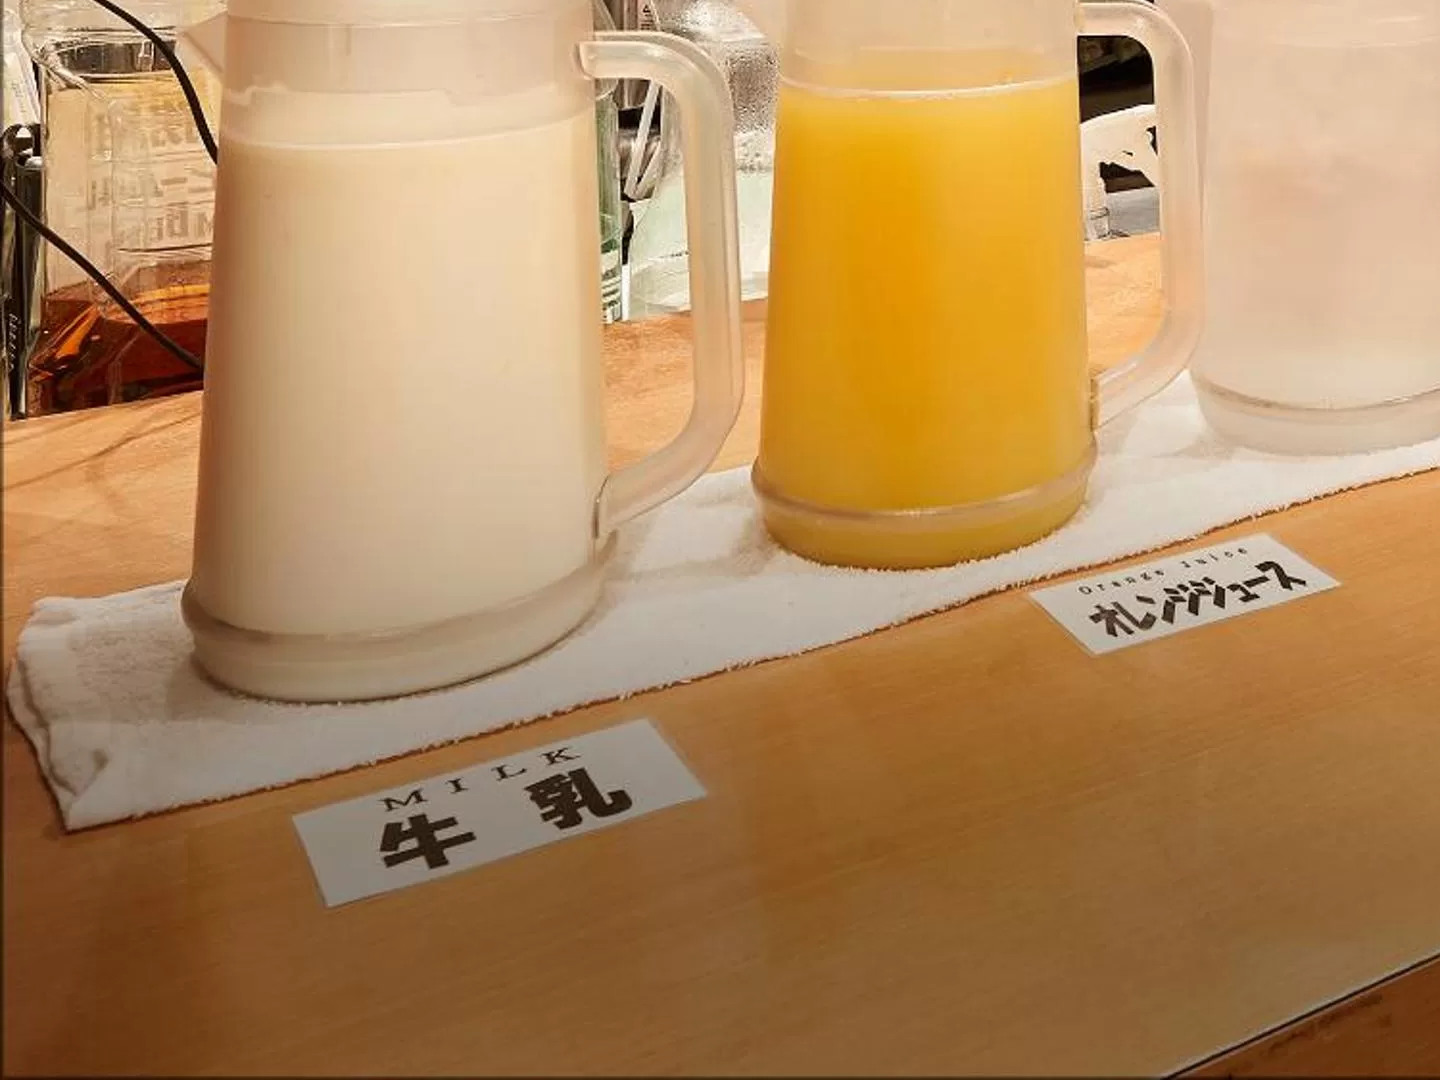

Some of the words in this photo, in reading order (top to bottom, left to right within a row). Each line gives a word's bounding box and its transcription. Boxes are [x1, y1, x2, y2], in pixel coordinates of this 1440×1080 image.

[1077, 569, 1166, 596] Orange
[1180, 546, 1250, 570] Juice
[1088, 560, 1308, 638] オレンジジュース
[378, 746, 581, 813] MILK
[379, 766, 633, 870] 牛乳
